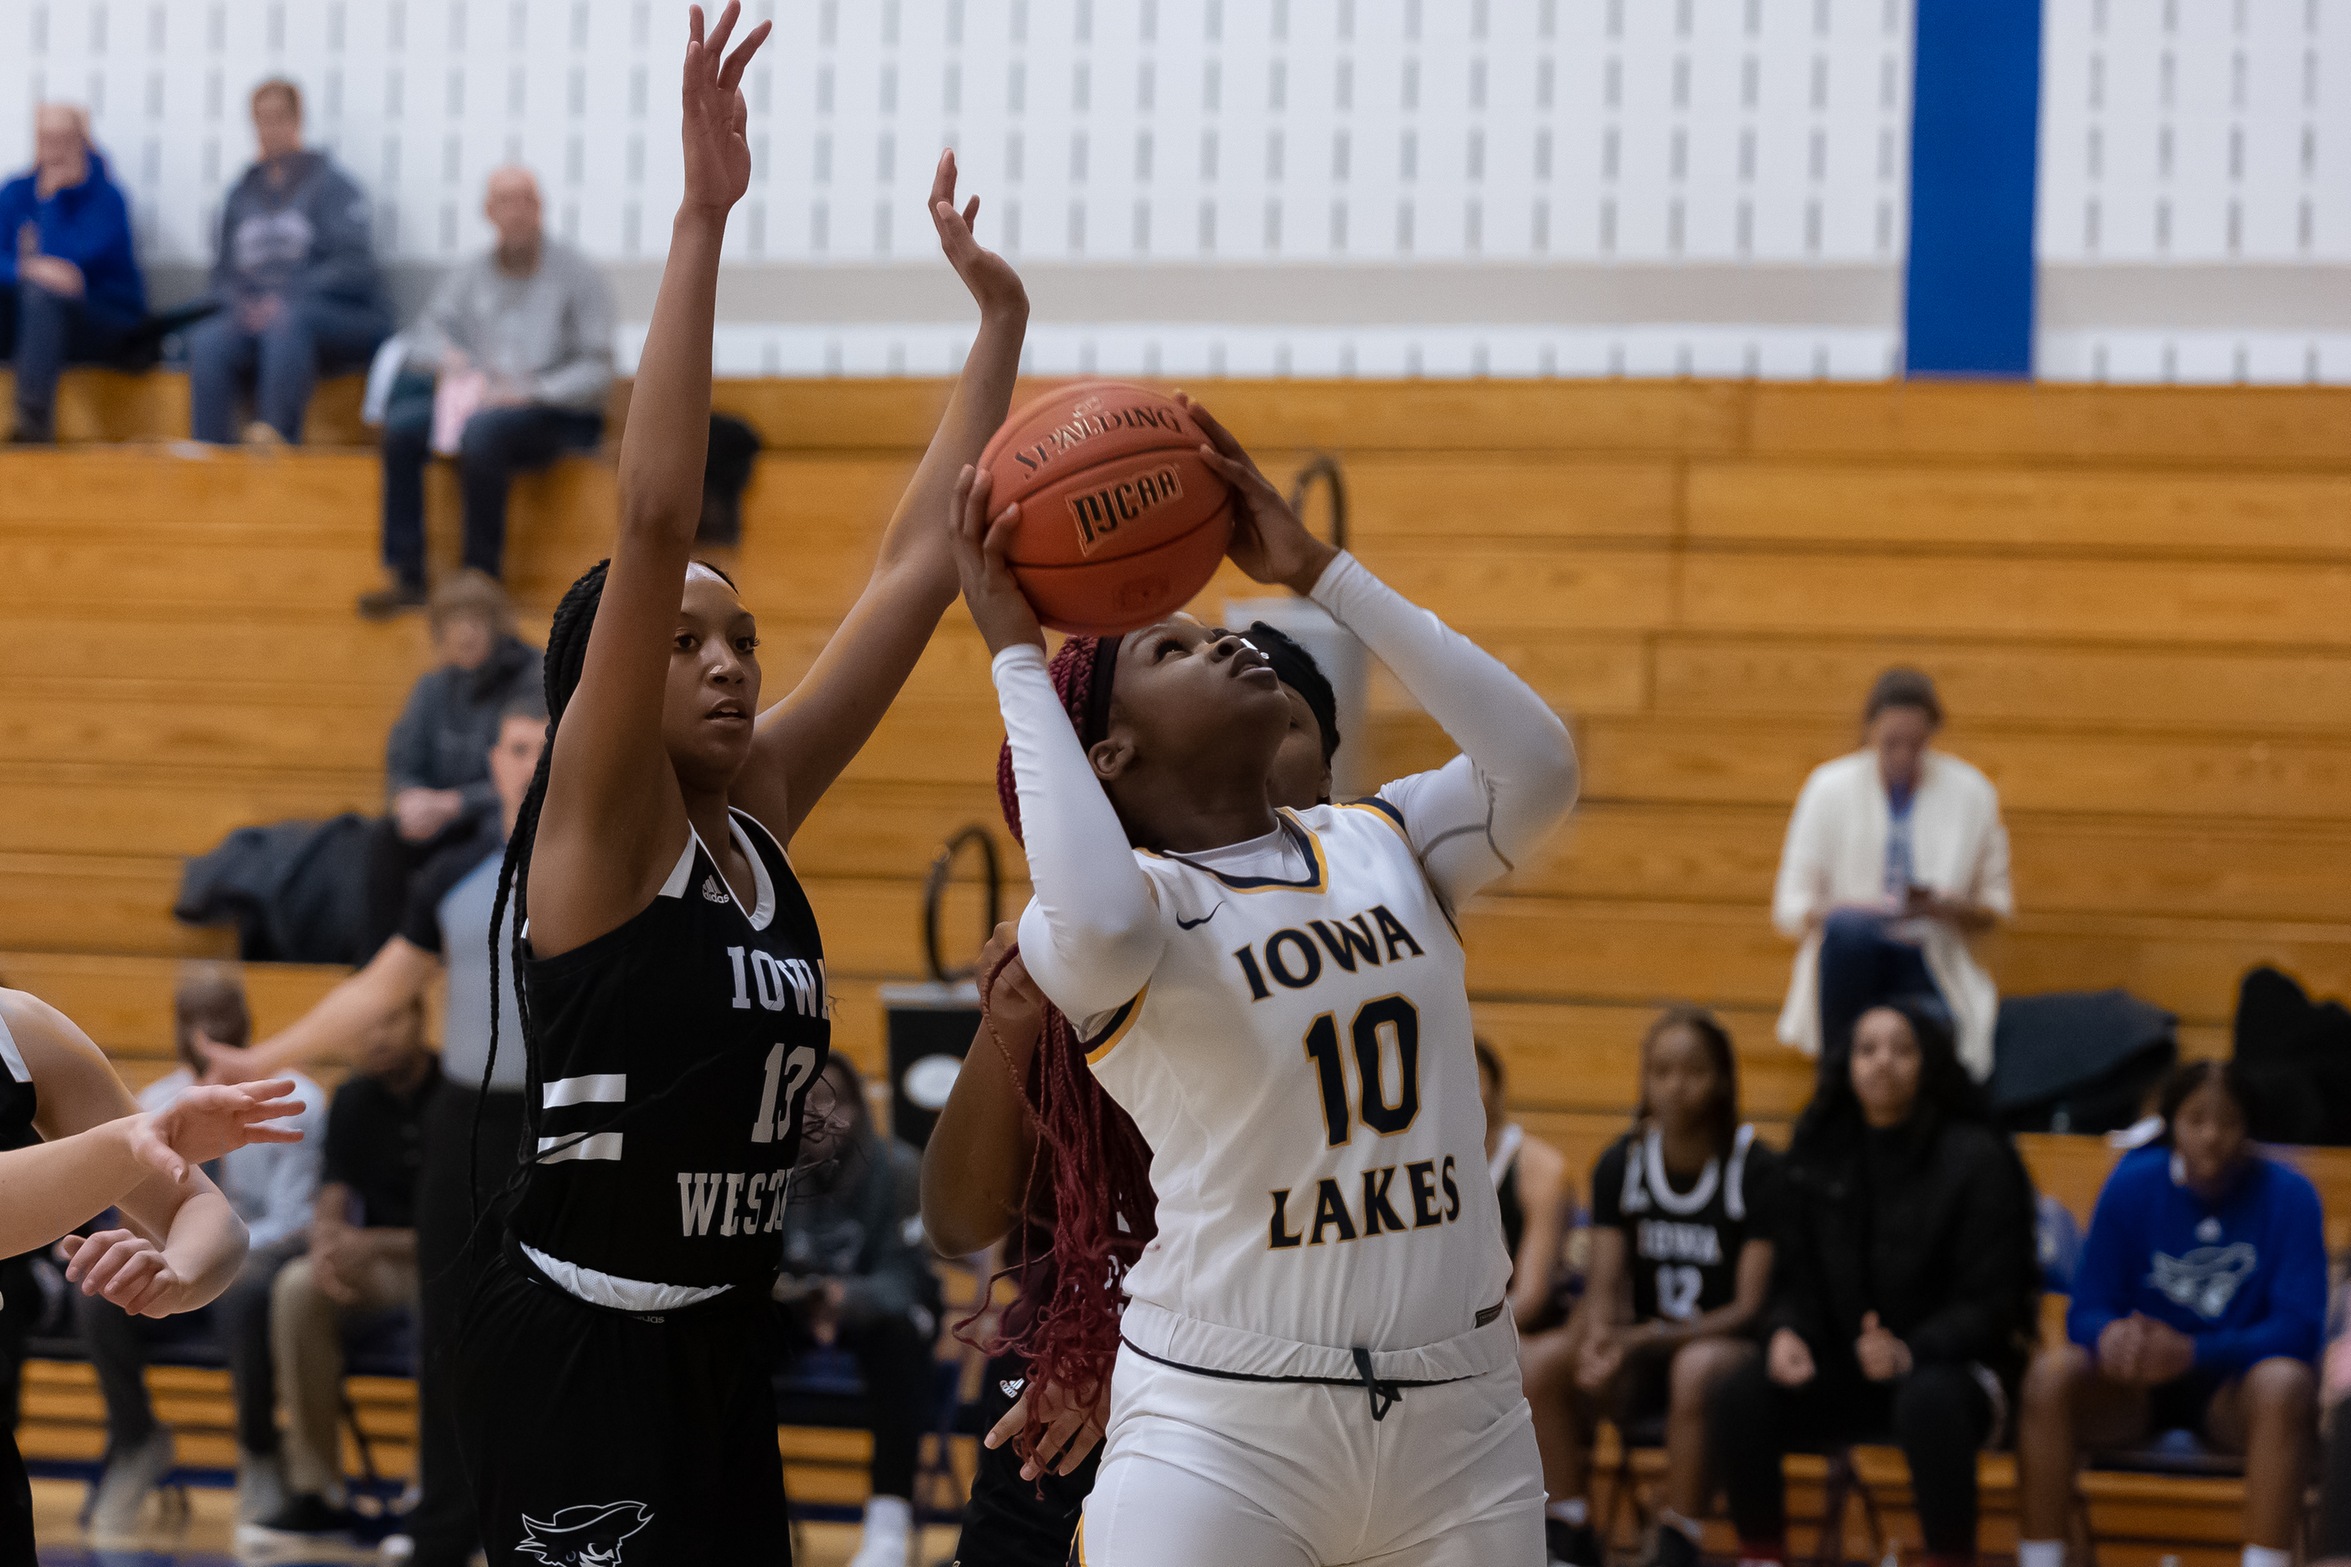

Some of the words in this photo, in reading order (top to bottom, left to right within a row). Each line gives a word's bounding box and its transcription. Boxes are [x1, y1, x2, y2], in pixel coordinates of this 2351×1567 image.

[1014, 405, 1184, 481] SPALDING
[1070, 467, 1180, 549] NJCAA
[1233, 905, 1424, 1001] IOWA
[751, 1043, 816, 1143] 13
[1302, 992, 1420, 1149] 10
[1267, 1155, 1461, 1250] LAKES
